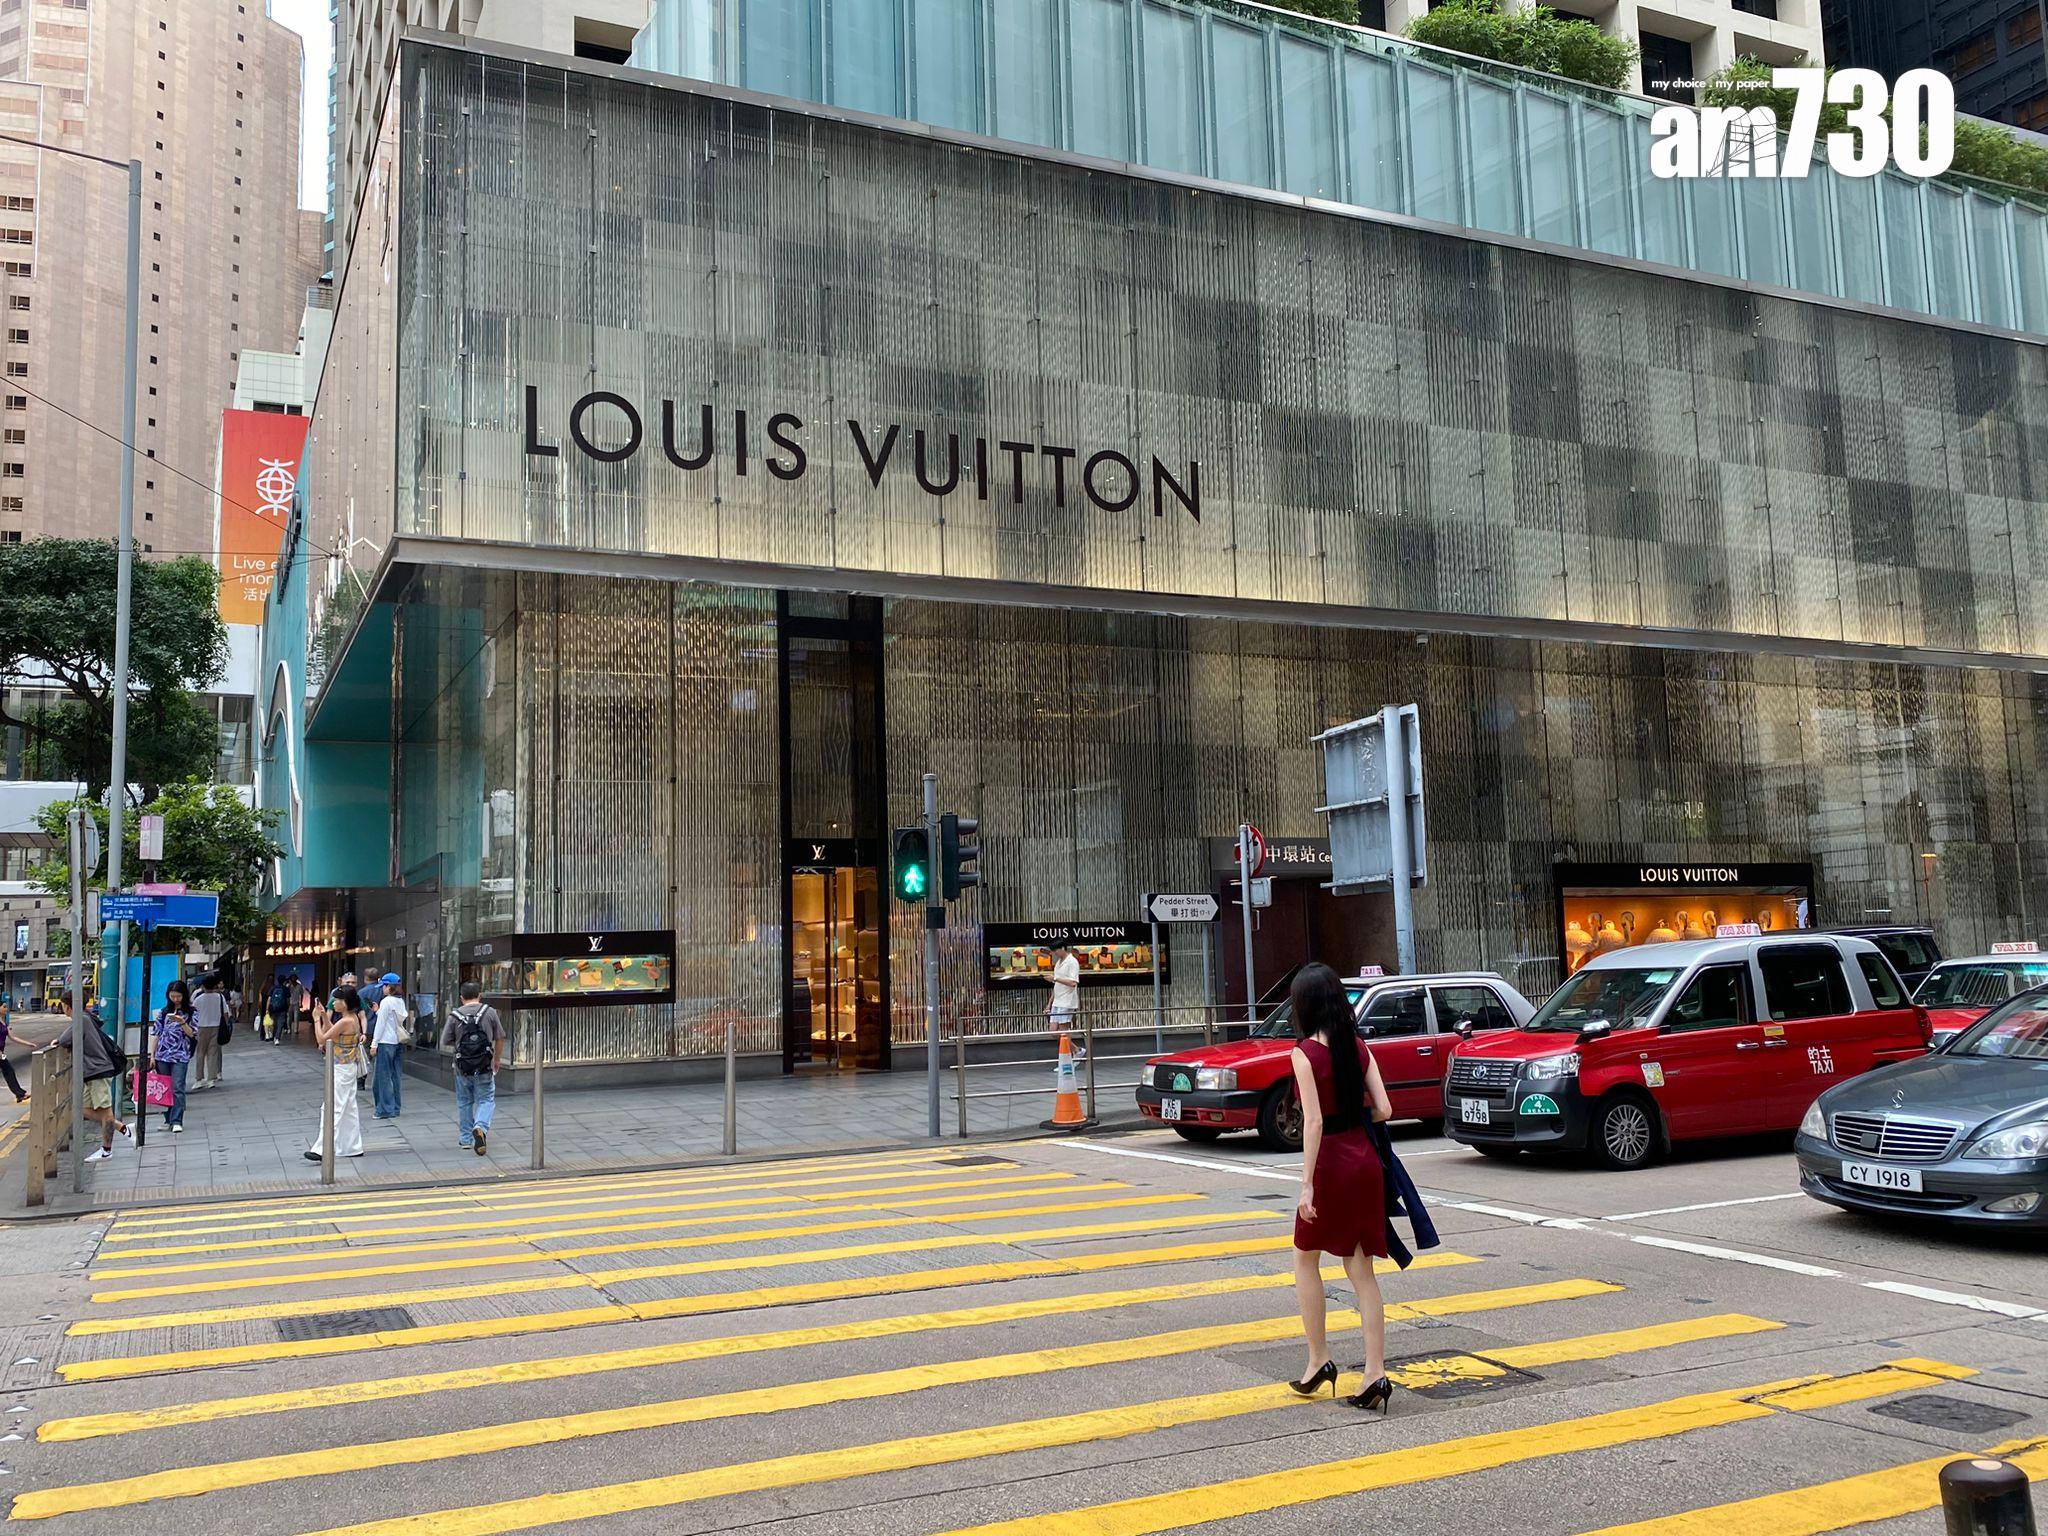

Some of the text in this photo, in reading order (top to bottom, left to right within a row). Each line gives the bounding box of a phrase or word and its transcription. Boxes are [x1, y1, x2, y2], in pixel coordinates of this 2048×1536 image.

[526, 385, 1200, 524] LOUIS VUITTON
[233, 555, 266, 570] Live
[1265, 845, 1316, 863] 中環站
[1640, 868, 1739, 882] LOUIS VUITTON
[1159, 897, 1209, 905] Pedder Street
[1033, 926, 1125, 939] LOUIS VUITTON
[1719, 925, 1752, 936] TAXI
[1994, 943, 2033, 952] TAXI
[1807, 1045, 1832, 1060] 的士
[1809, 1059, 1834, 1075] TAXI
[1469, 1100, 1481, 1111] JZ
[1534, 1100, 1543, 1108] 4
[1464, 1110, 1487, 1123] 9798
[1850, 1166, 1911, 1188] CY 1918
